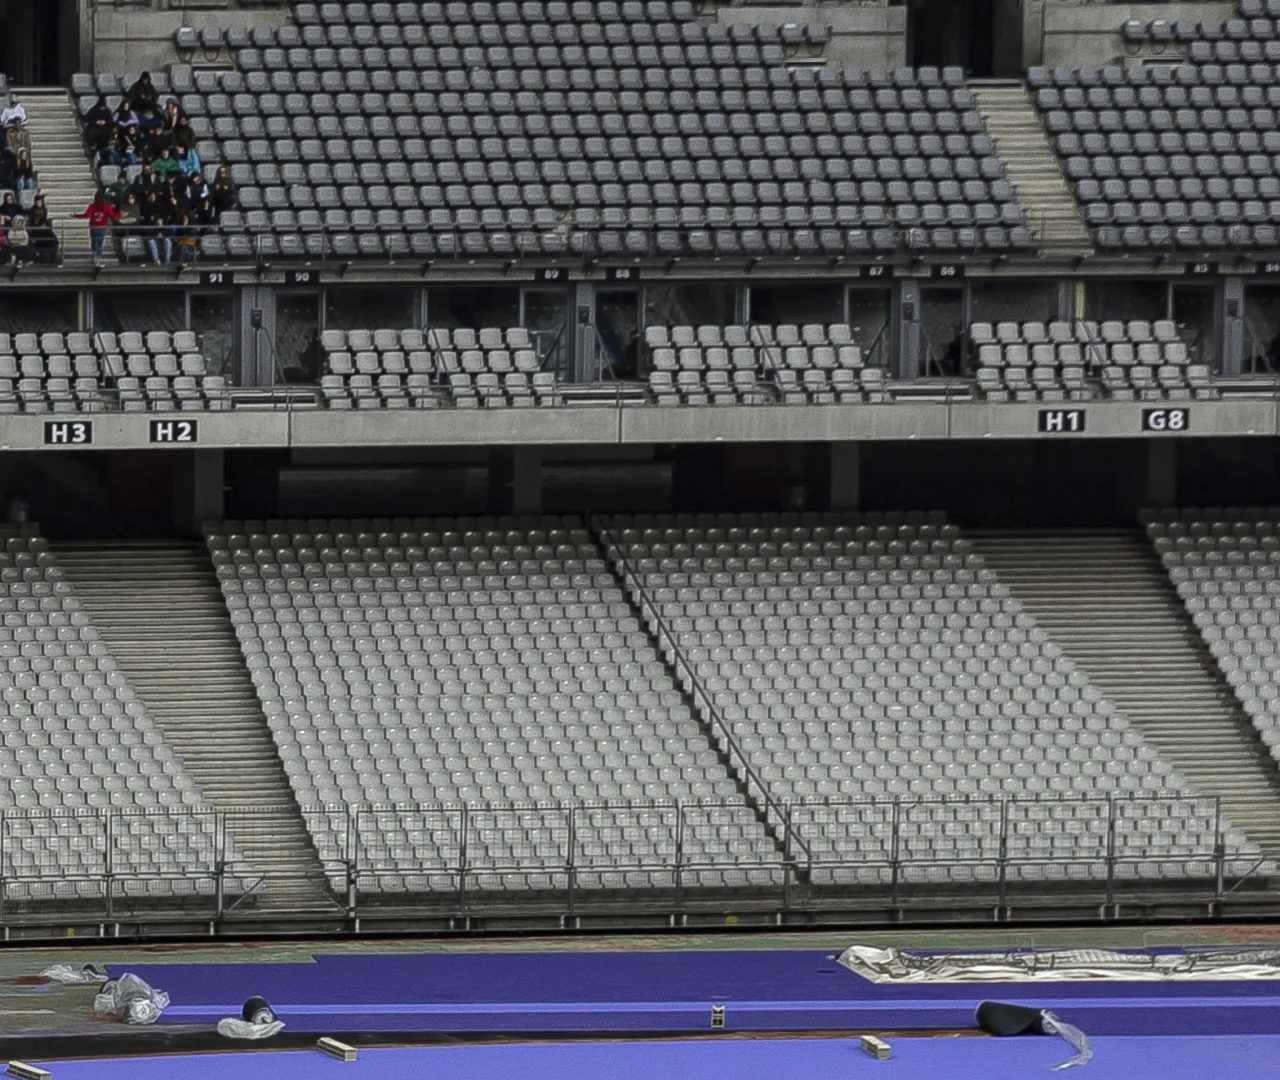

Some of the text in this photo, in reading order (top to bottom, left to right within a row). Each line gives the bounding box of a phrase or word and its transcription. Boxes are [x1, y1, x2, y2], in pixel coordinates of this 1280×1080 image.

[209, 273, 223, 283] 91
[295, 272, 310, 282] 90
[1046, 411, 1080, 432] H1
[1148, 410, 1184, 430] G8
[52, 423, 86, 443] H3
[156, 421, 192, 441] H2
